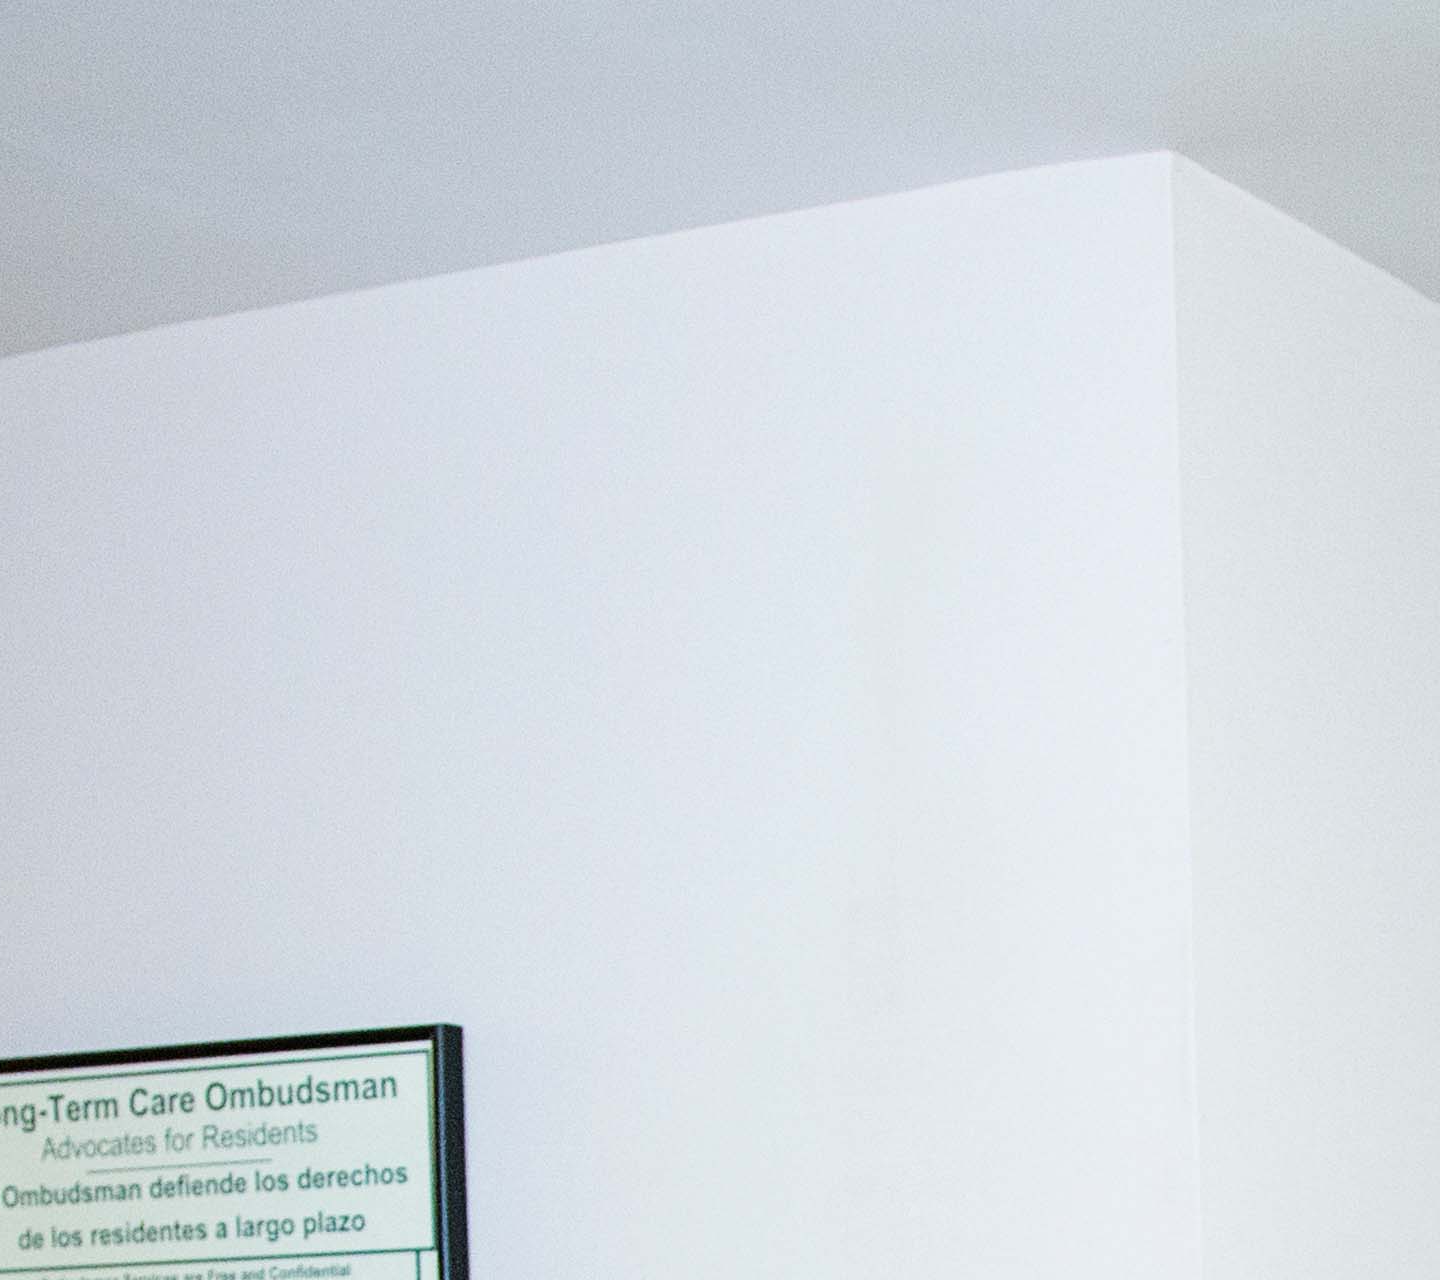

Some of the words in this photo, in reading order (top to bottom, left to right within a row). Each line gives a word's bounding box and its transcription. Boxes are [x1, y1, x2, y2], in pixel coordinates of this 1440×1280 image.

[129, 1088, 195, 1117] Care
[205, 1074, 398, 1111] Ombudsman
[42, 1132, 157, 1160] Advocates
[164, 1127, 194, 1152] for
[202, 1121, 318, 1149] Residents
[1, 1178, 141, 1208] Ombudsman
[149, 1173, 247, 1199] defiende
[254, 1171, 289, 1192] los
[297, 1163, 408, 1190] derechos
[18, 1228, 44, 1250] de
[50, 1227, 83, 1248] los
[90, 1219, 207, 1245] residentes
[215, 1221, 227, 1239] a
[236, 1214, 295, 1243] largo
[303, 1211, 366, 1239] plazo
